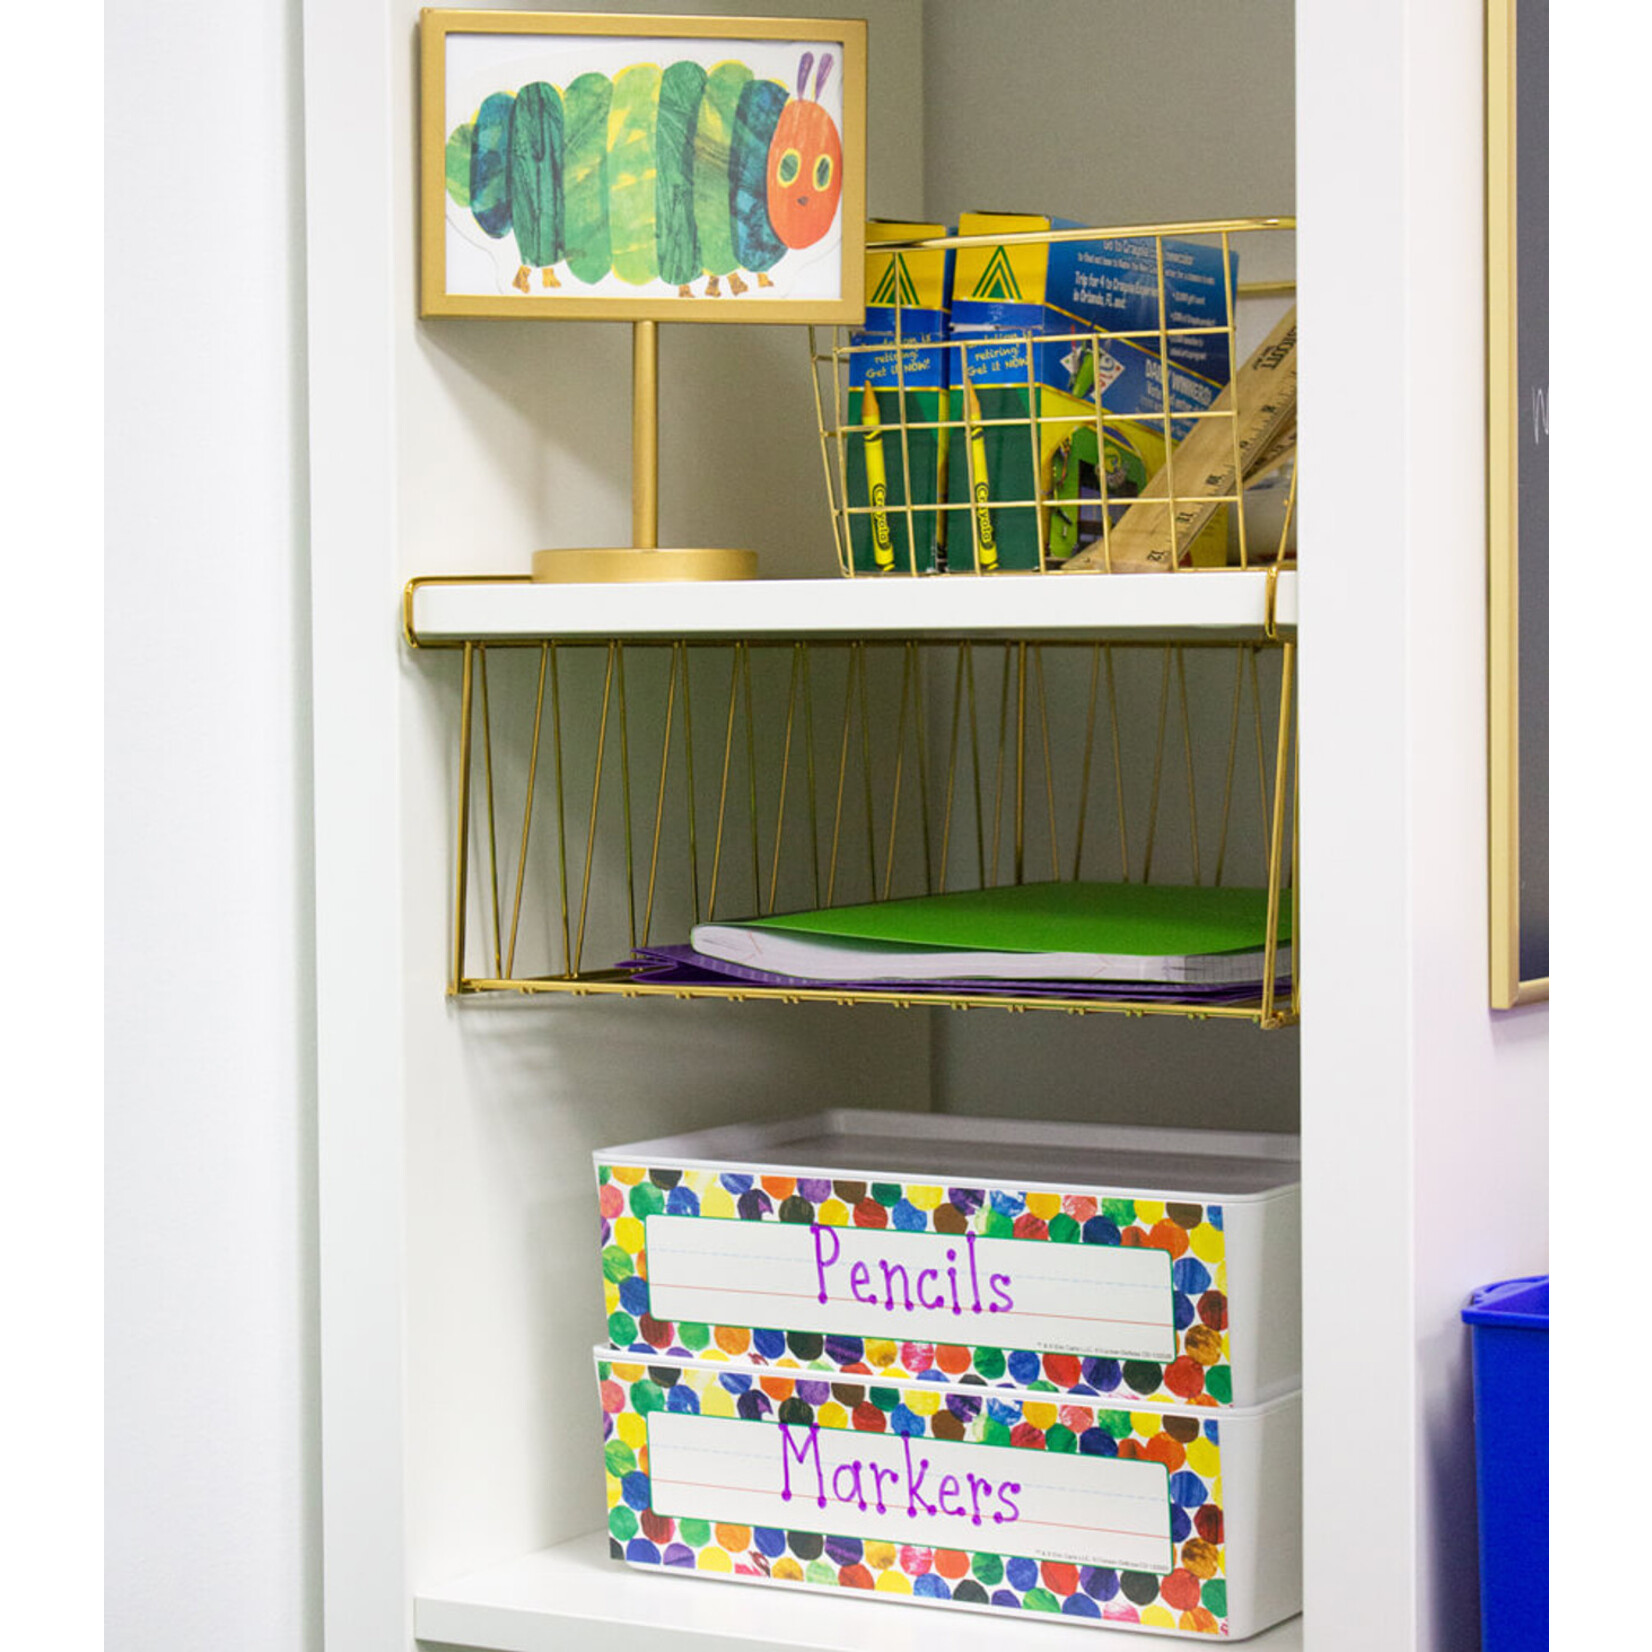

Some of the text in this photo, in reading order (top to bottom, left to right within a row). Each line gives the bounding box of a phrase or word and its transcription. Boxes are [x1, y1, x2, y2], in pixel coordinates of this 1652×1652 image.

[866, 366, 886, 378] Get
[873, 484, 890, 545] Cryola
[975, 483, 993, 545] Cryola
[810, 1223, 1013, 1314] Pencils
[779, 1423, 1021, 1526] Markers
